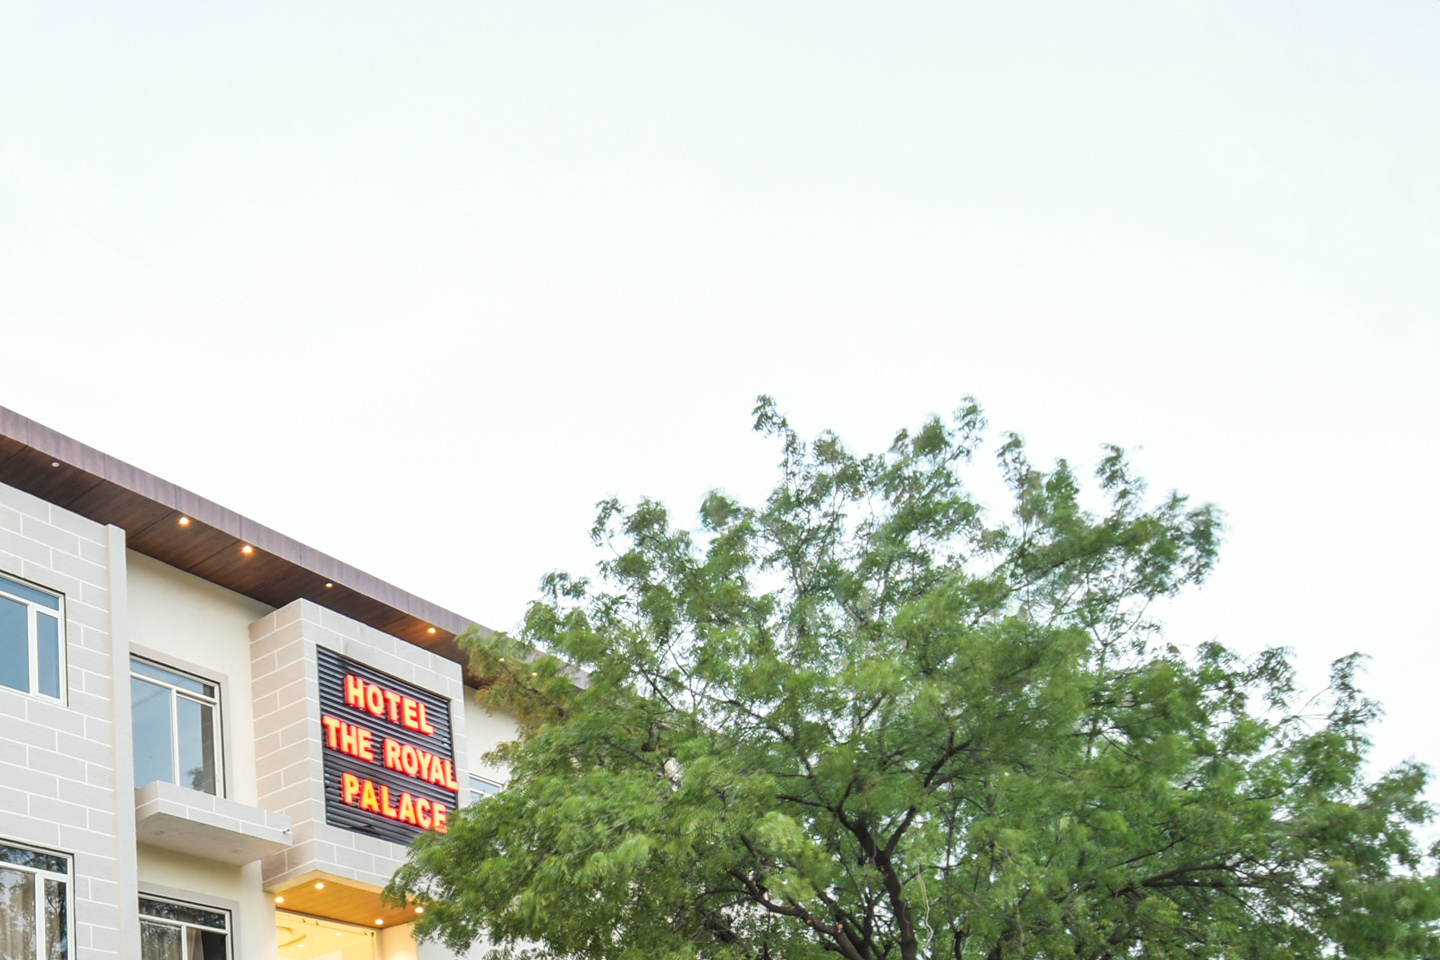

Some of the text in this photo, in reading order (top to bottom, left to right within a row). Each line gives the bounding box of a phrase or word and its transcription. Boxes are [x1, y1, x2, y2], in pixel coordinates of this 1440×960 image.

[344, 674, 435, 736] HOTEL
[322, 715, 459, 792] THE ROYAL
[341, 772, 448, 834] PALACE
